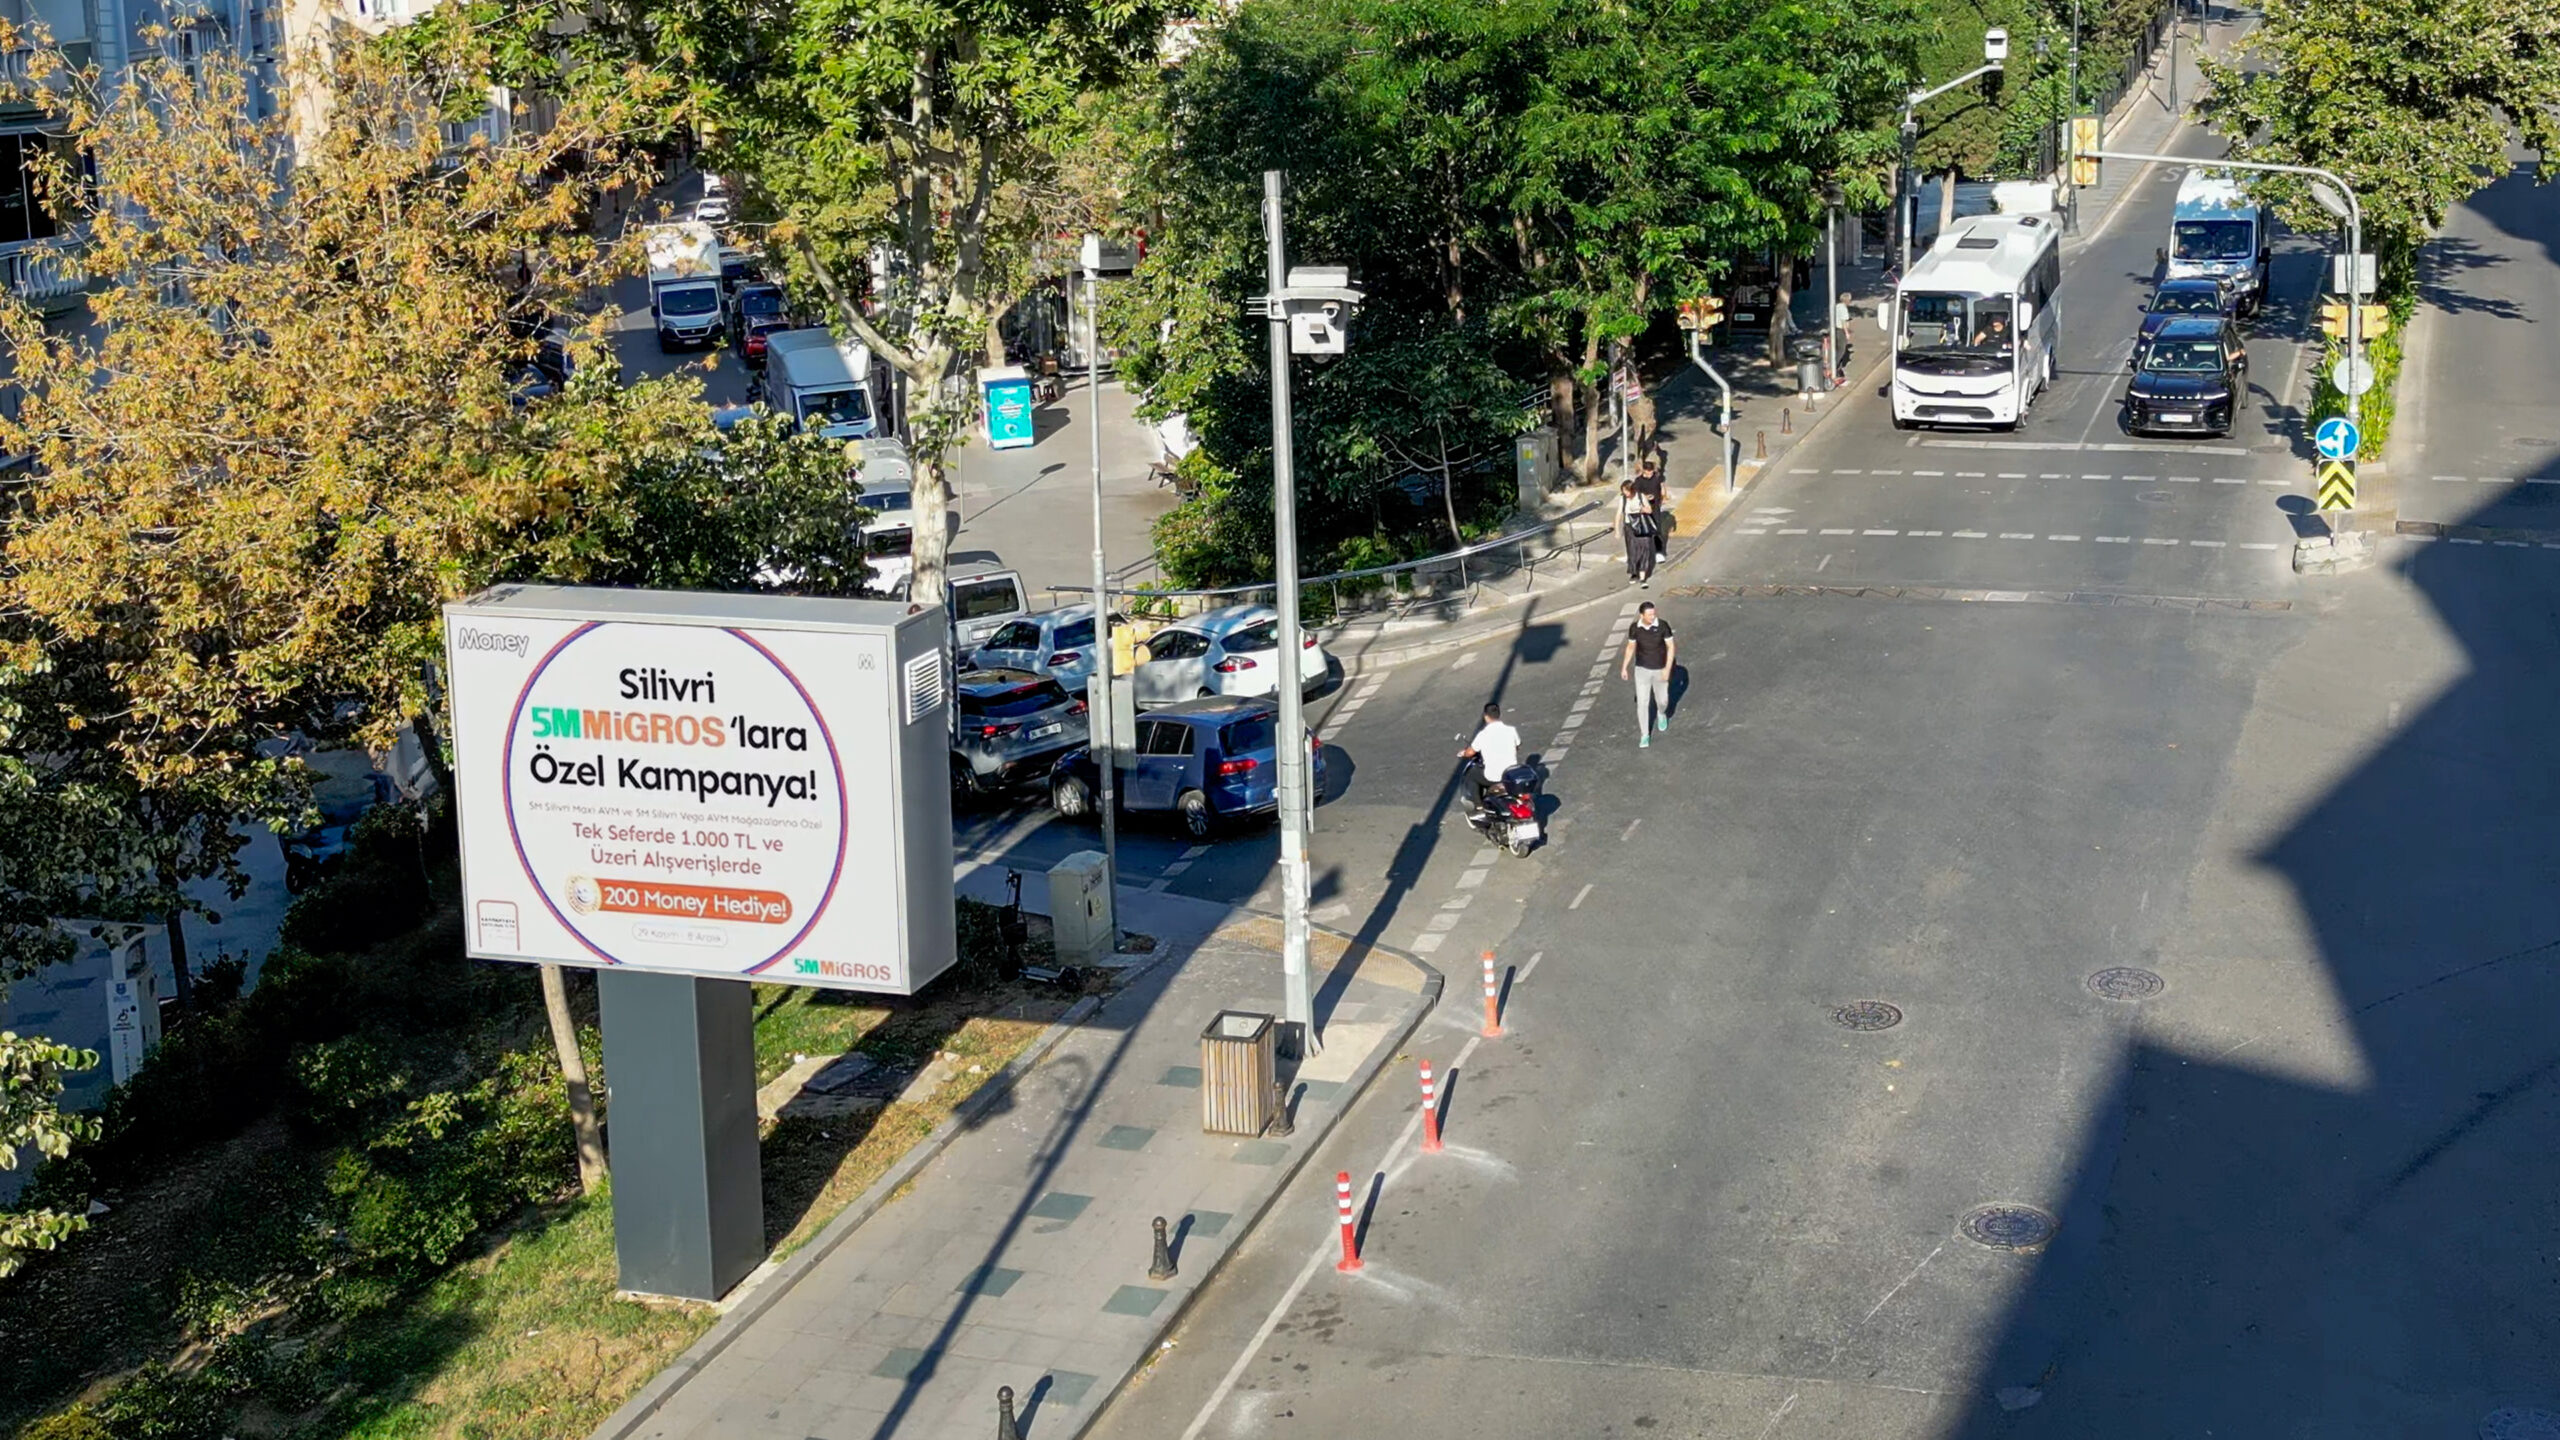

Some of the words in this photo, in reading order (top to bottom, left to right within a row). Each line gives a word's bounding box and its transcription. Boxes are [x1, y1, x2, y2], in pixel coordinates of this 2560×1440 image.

[459, 626, 529, 658] Money
[619, 667, 715, 703] Silivri
[530, 743, 605, 787] Özel
[618, 757, 817, 808] Kampanya!
[599, 806, 620, 816] AVM
[621, 808, 633, 816] ve
[707, 813, 729, 823] AVM
[572, 822, 603, 841] Tek
[608, 825, 676, 845] Seferde
[681, 830, 729, 848] 1.000
[734, 832, 757, 850] TL
[762, 837, 784, 852] ve
[591, 843, 637, 866] Üzeri
[643, 851, 762, 877] Alışverişlerde
[604, 886, 639, 907] 200
[644, 890, 708, 917] Money
[713, 894, 787, 922] Hediye!
